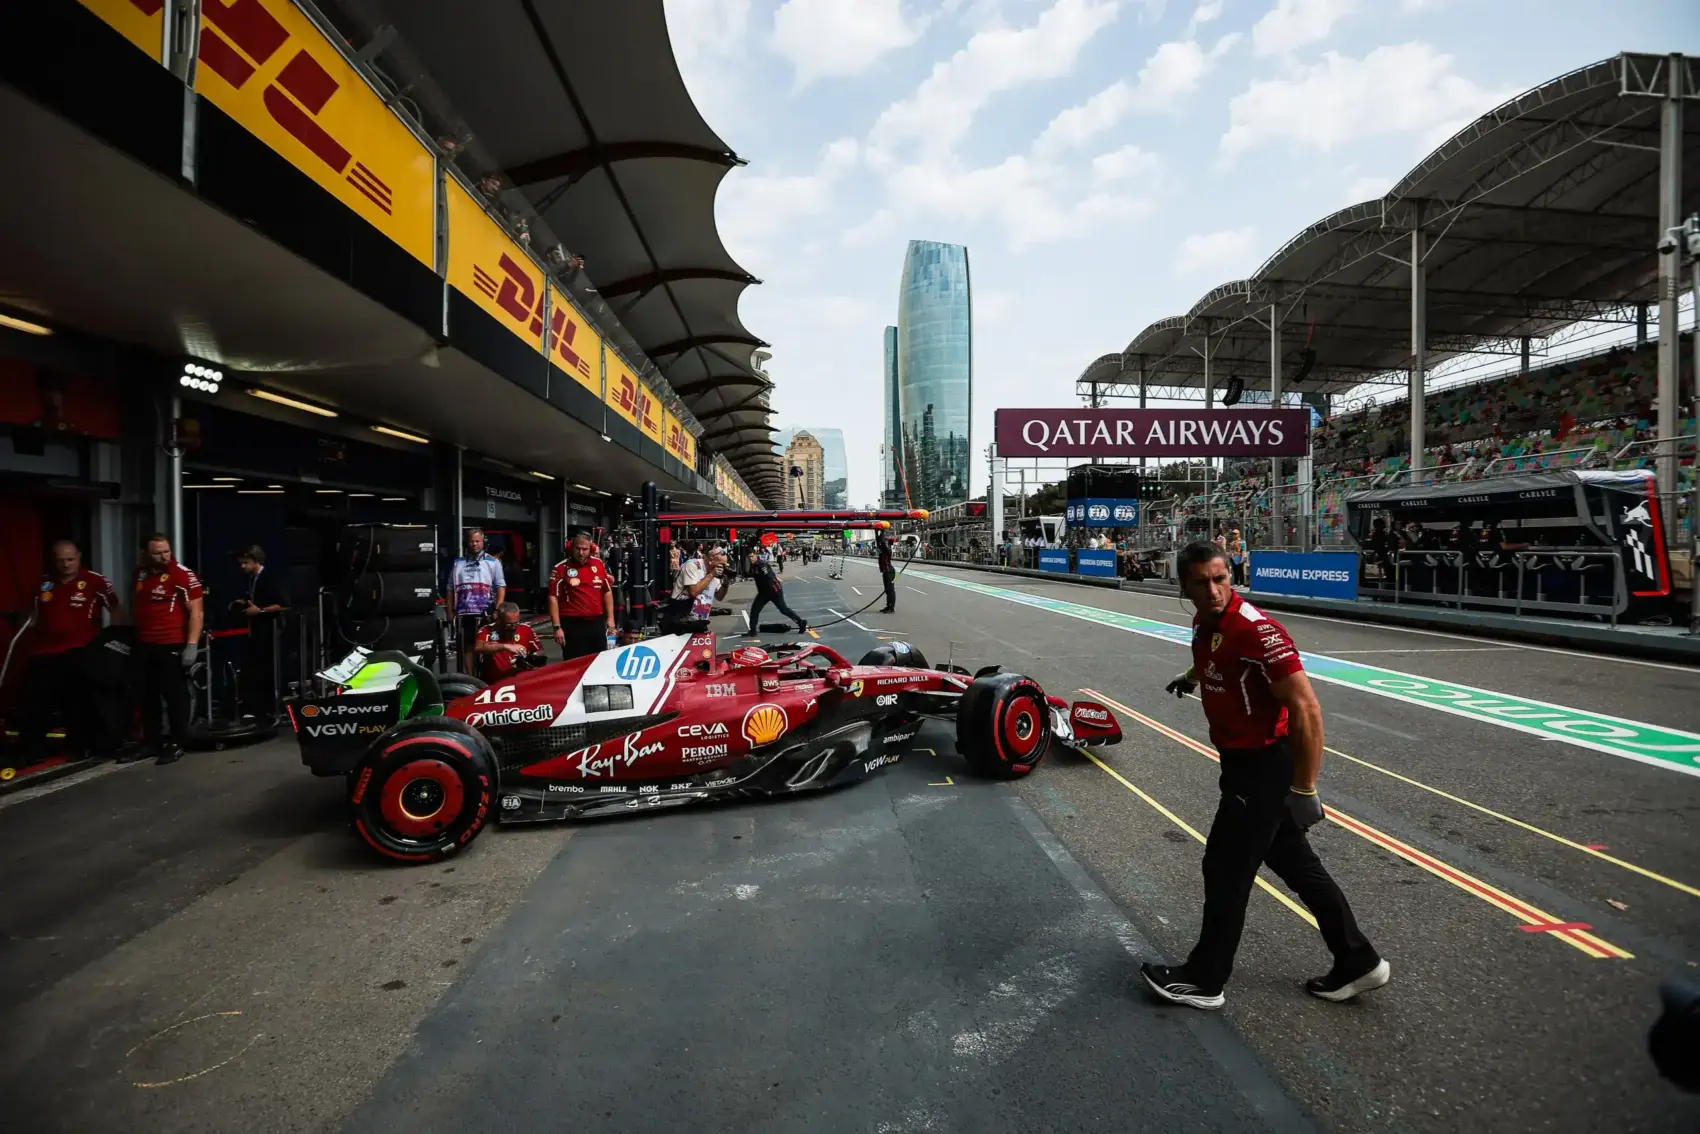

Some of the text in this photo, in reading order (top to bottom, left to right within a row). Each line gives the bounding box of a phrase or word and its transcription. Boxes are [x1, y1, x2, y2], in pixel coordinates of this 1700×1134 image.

[496, 252, 580, 369] DHL
[620, 373, 652, 429] DHL
[1022, 420, 1284, 451] QATAR AIRWAYS
[1520, 489, 1556, 498] CARLYLE
[1089, 507, 1109, 517] FIA
[1115, 508, 1135, 518] FIA
[1256, 567, 1349, 582] AMERICAN EXPRESS
[692, 637, 712, 646] ZCG
[621, 646, 656, 680] hp
[762, 680, 780, 688] aws
[877, 675, 929, 685] RICHARD MILLE
[474, 685, 517, 705] 16
[705, 682, 737, 697] IBM
[320, 704, 388, 716] V-Power
[485, 704, 553, 726] UniCredit
[306, 722, 388, 738] VGW PLAY
[883, 731, 911, 744] ambipar
[681, 744, 728, 759] PERONI
[864, 754, 900, 773] VGW PLAY
[549, 784, 584, 793] brembo
[640, 785, 659, 793] NGK
[670, 782, 693, 790] SKF
